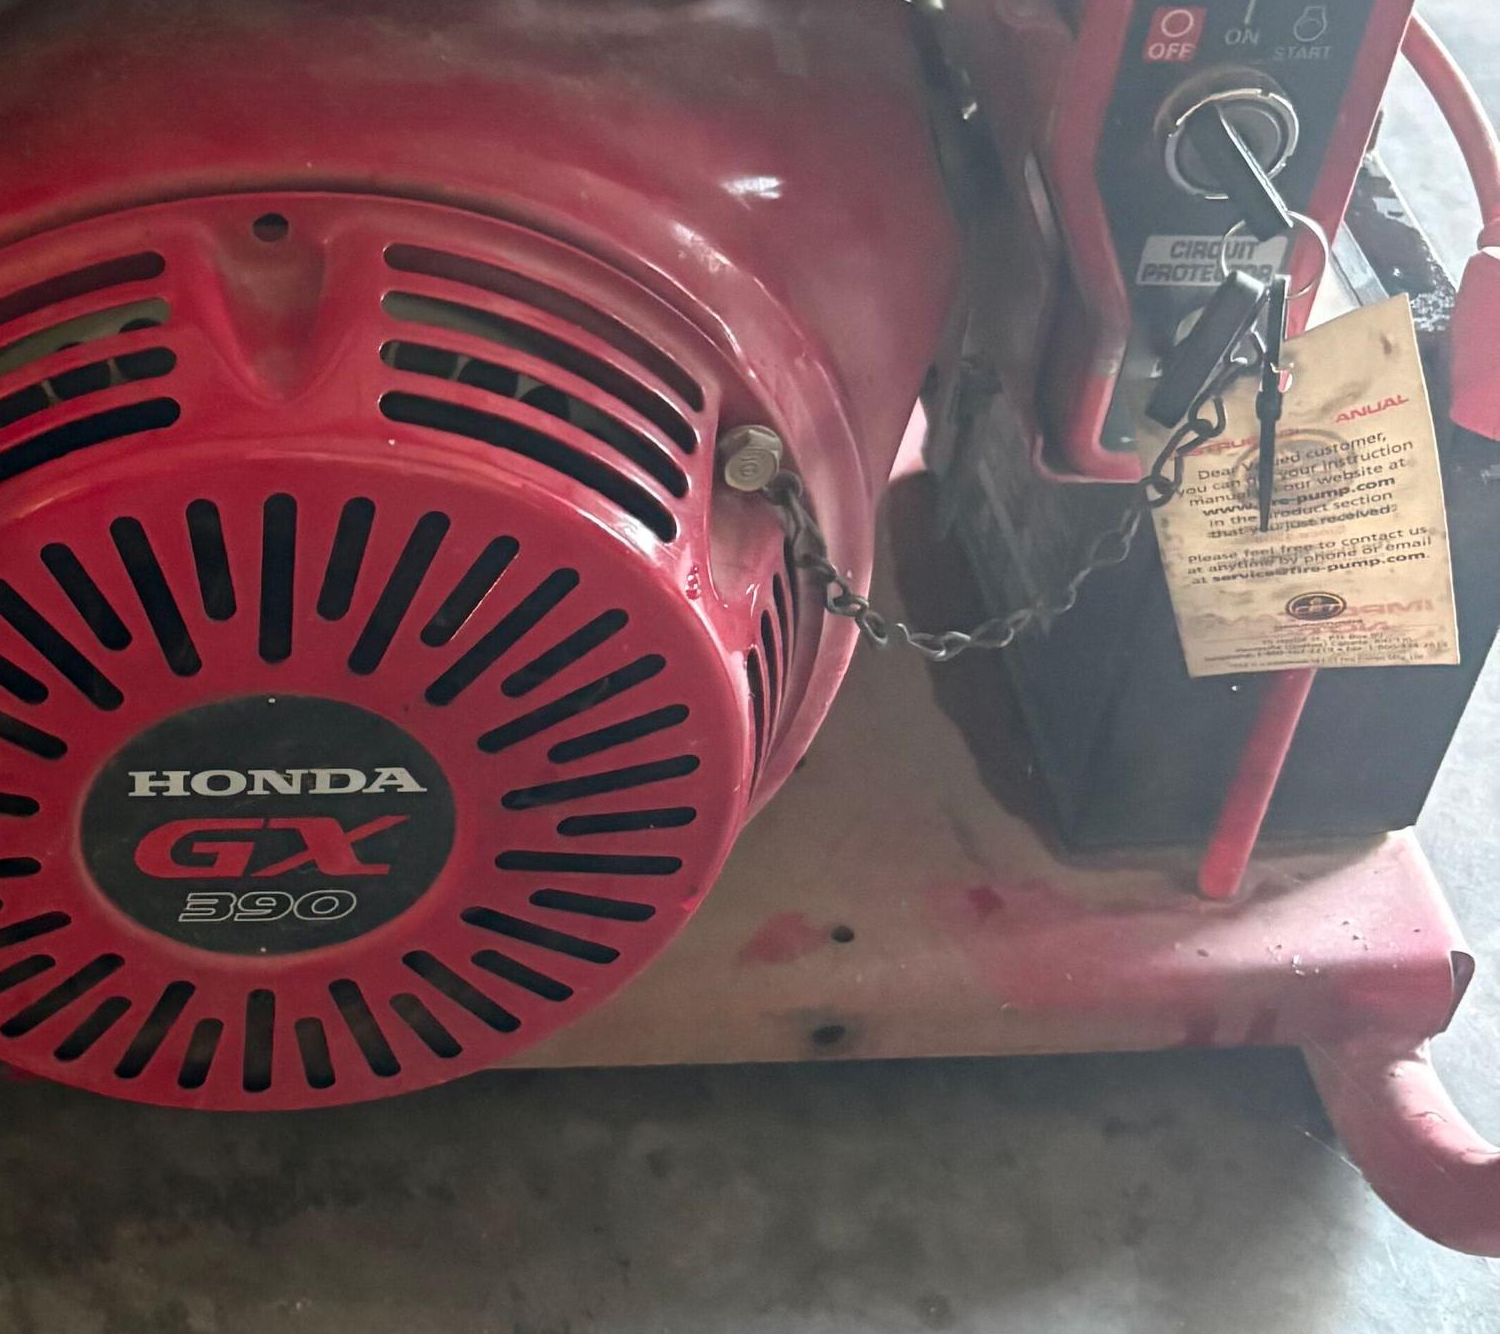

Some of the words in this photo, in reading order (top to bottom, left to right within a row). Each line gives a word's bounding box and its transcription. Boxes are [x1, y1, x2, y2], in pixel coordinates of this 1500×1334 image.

[1147, 42, 1195, 60] OFF
[1225, 28, 1259, 45] ON
[1272, 44, 1332, 60] START
[1177, 486, 1207, 499] you
[1213, 480, 1241, 491] can
[1323, 441, 1414, 471] instruction
[1198, 467, 1238, 481] Dear
[1306, 432, 1387, 459] customer,
[1317, 464, 1383, 486] website
[1389, 458, 1407, 471] at
[1210, 519, 1225, 528] in
[1230, 515, 1258, 526] the
[1333, 491, 1393, 511] section
[1187, 566, 1203, 575] at
[1304, 548, 1358, 565] phone
[1362, 544, 1380, 556] or
[1385, 534, 1433, 552] email
[1188, 551, 1238, 564] Please
[1244, 546, 1275, 558] feel
[1281, 543, 1313, 555] free
[1319, 540, 1336, 550] to
[1341, 529, 1404, 548] contact
[1409, 526, 1428, 536] us
[1191, 576, 1208, 585] at
[128, 767, 429, 798] HONDA
[134, 815, 411, 879] GX
[178, 889, 357, 923] 390
